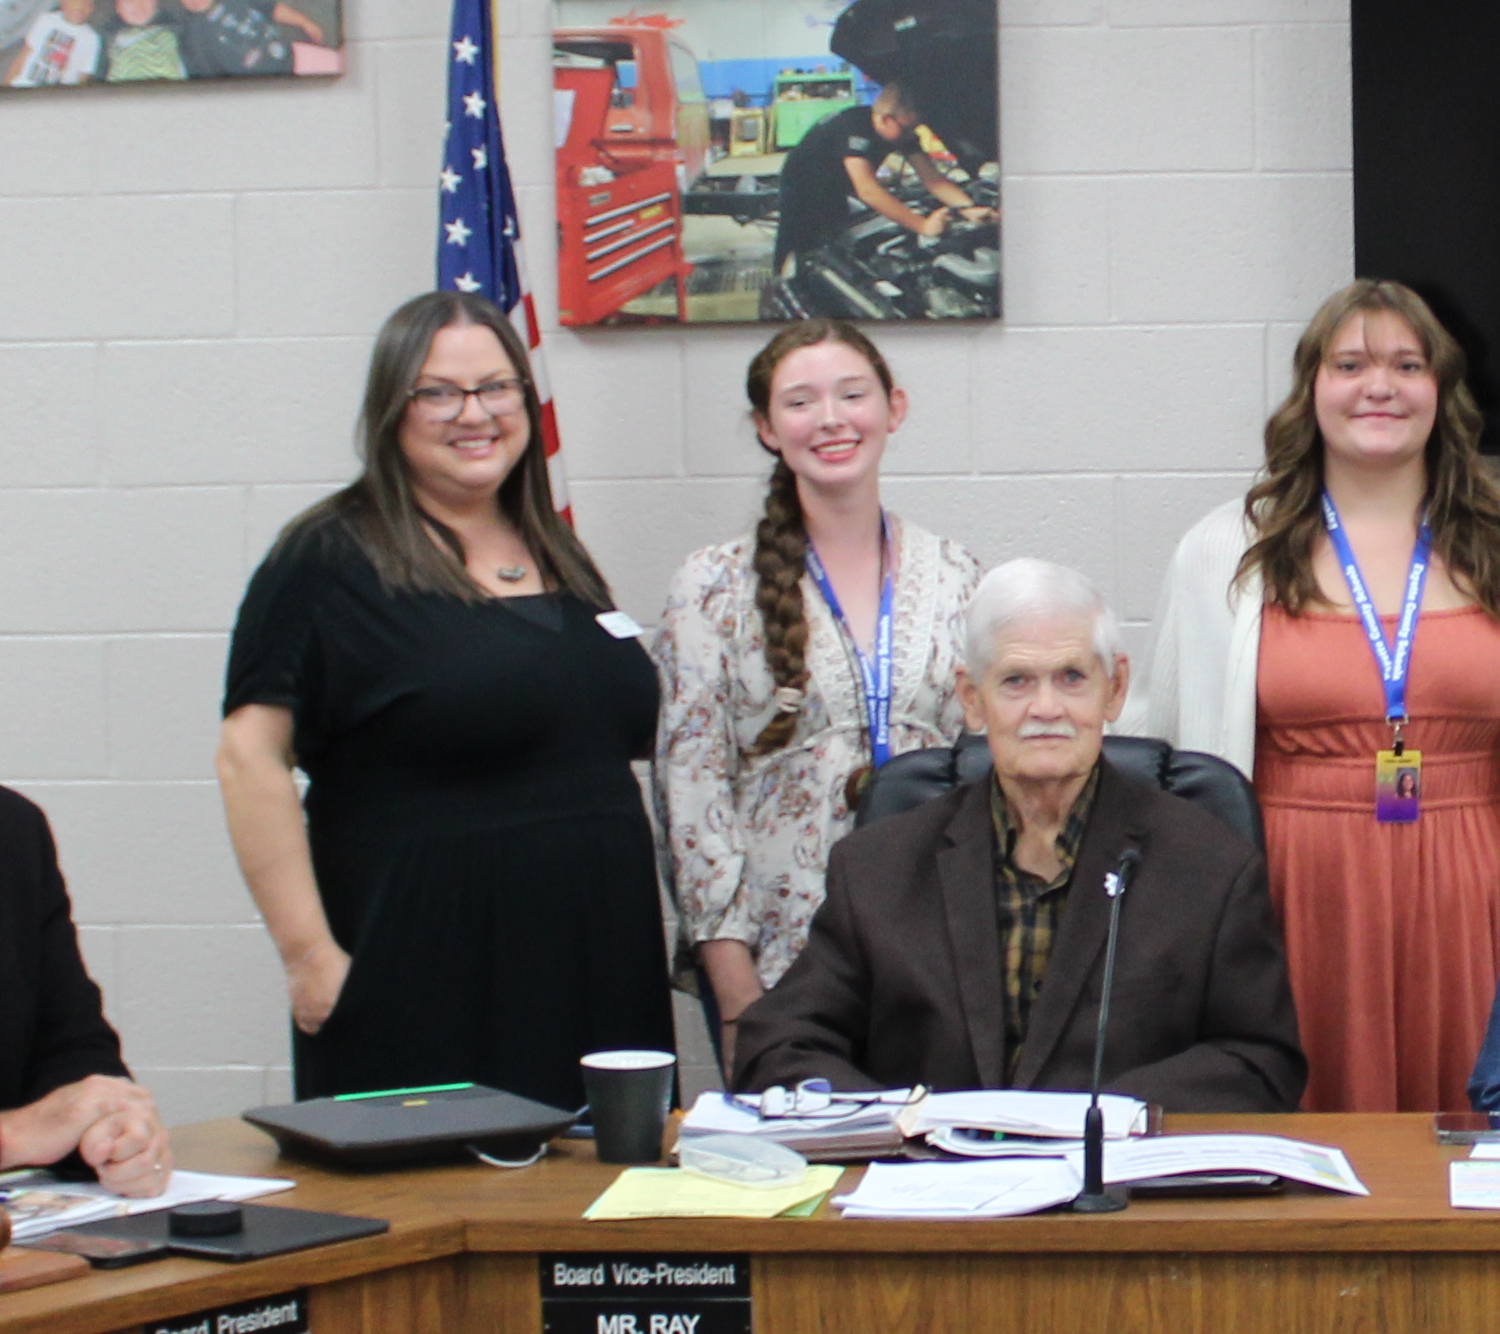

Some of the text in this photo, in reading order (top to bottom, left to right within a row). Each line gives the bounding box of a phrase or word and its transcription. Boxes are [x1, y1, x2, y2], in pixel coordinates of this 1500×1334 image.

[1346, 564, 1367, 603] Schools
[878, 615, 890, 655] Schools
[1361, 603, 1381, 640] County
[1392, 563, 1425, 681] Fayette County Schools
[877, 657, 891, 698] County
[554, 1263, 736, 1285] Board Vice-President
